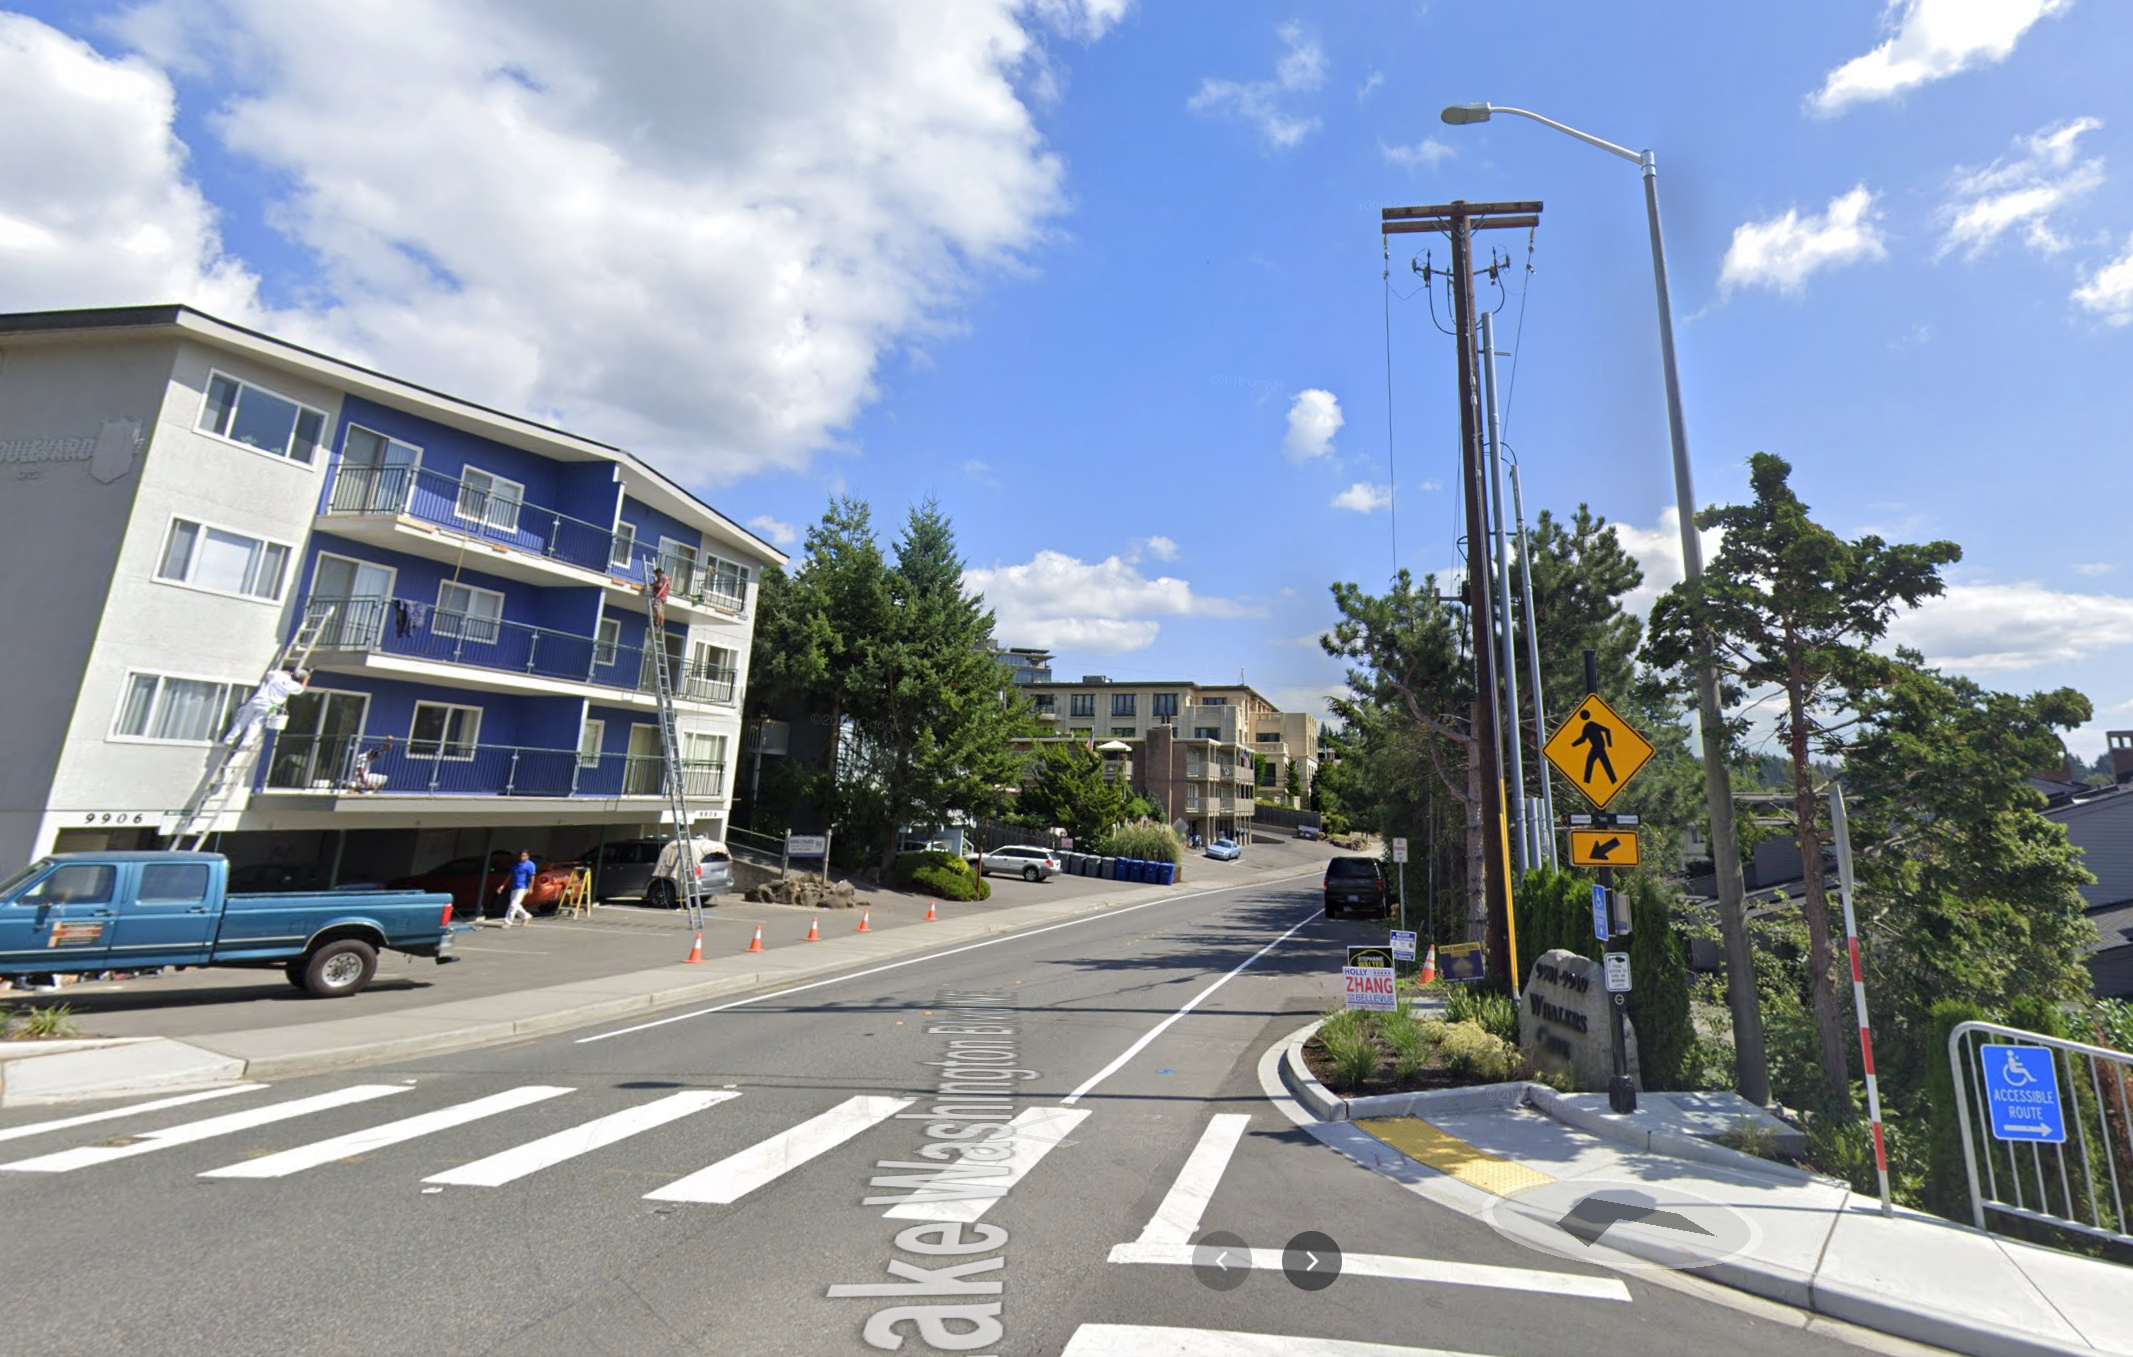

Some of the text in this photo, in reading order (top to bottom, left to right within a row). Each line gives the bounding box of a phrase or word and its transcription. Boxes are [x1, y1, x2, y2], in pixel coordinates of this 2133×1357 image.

[84, 812, 143, 824] 9906
[1345, 968, 1367, 976] HOLLY
[1345, 976, 1394, 994] ZHANG
[1355, 994, 1395, 1003] BELLEVUE
[1993, 1088, 2054, 1105] ACCESSIBLE
[2008, 1105, 2044, 1120] ROUTE
